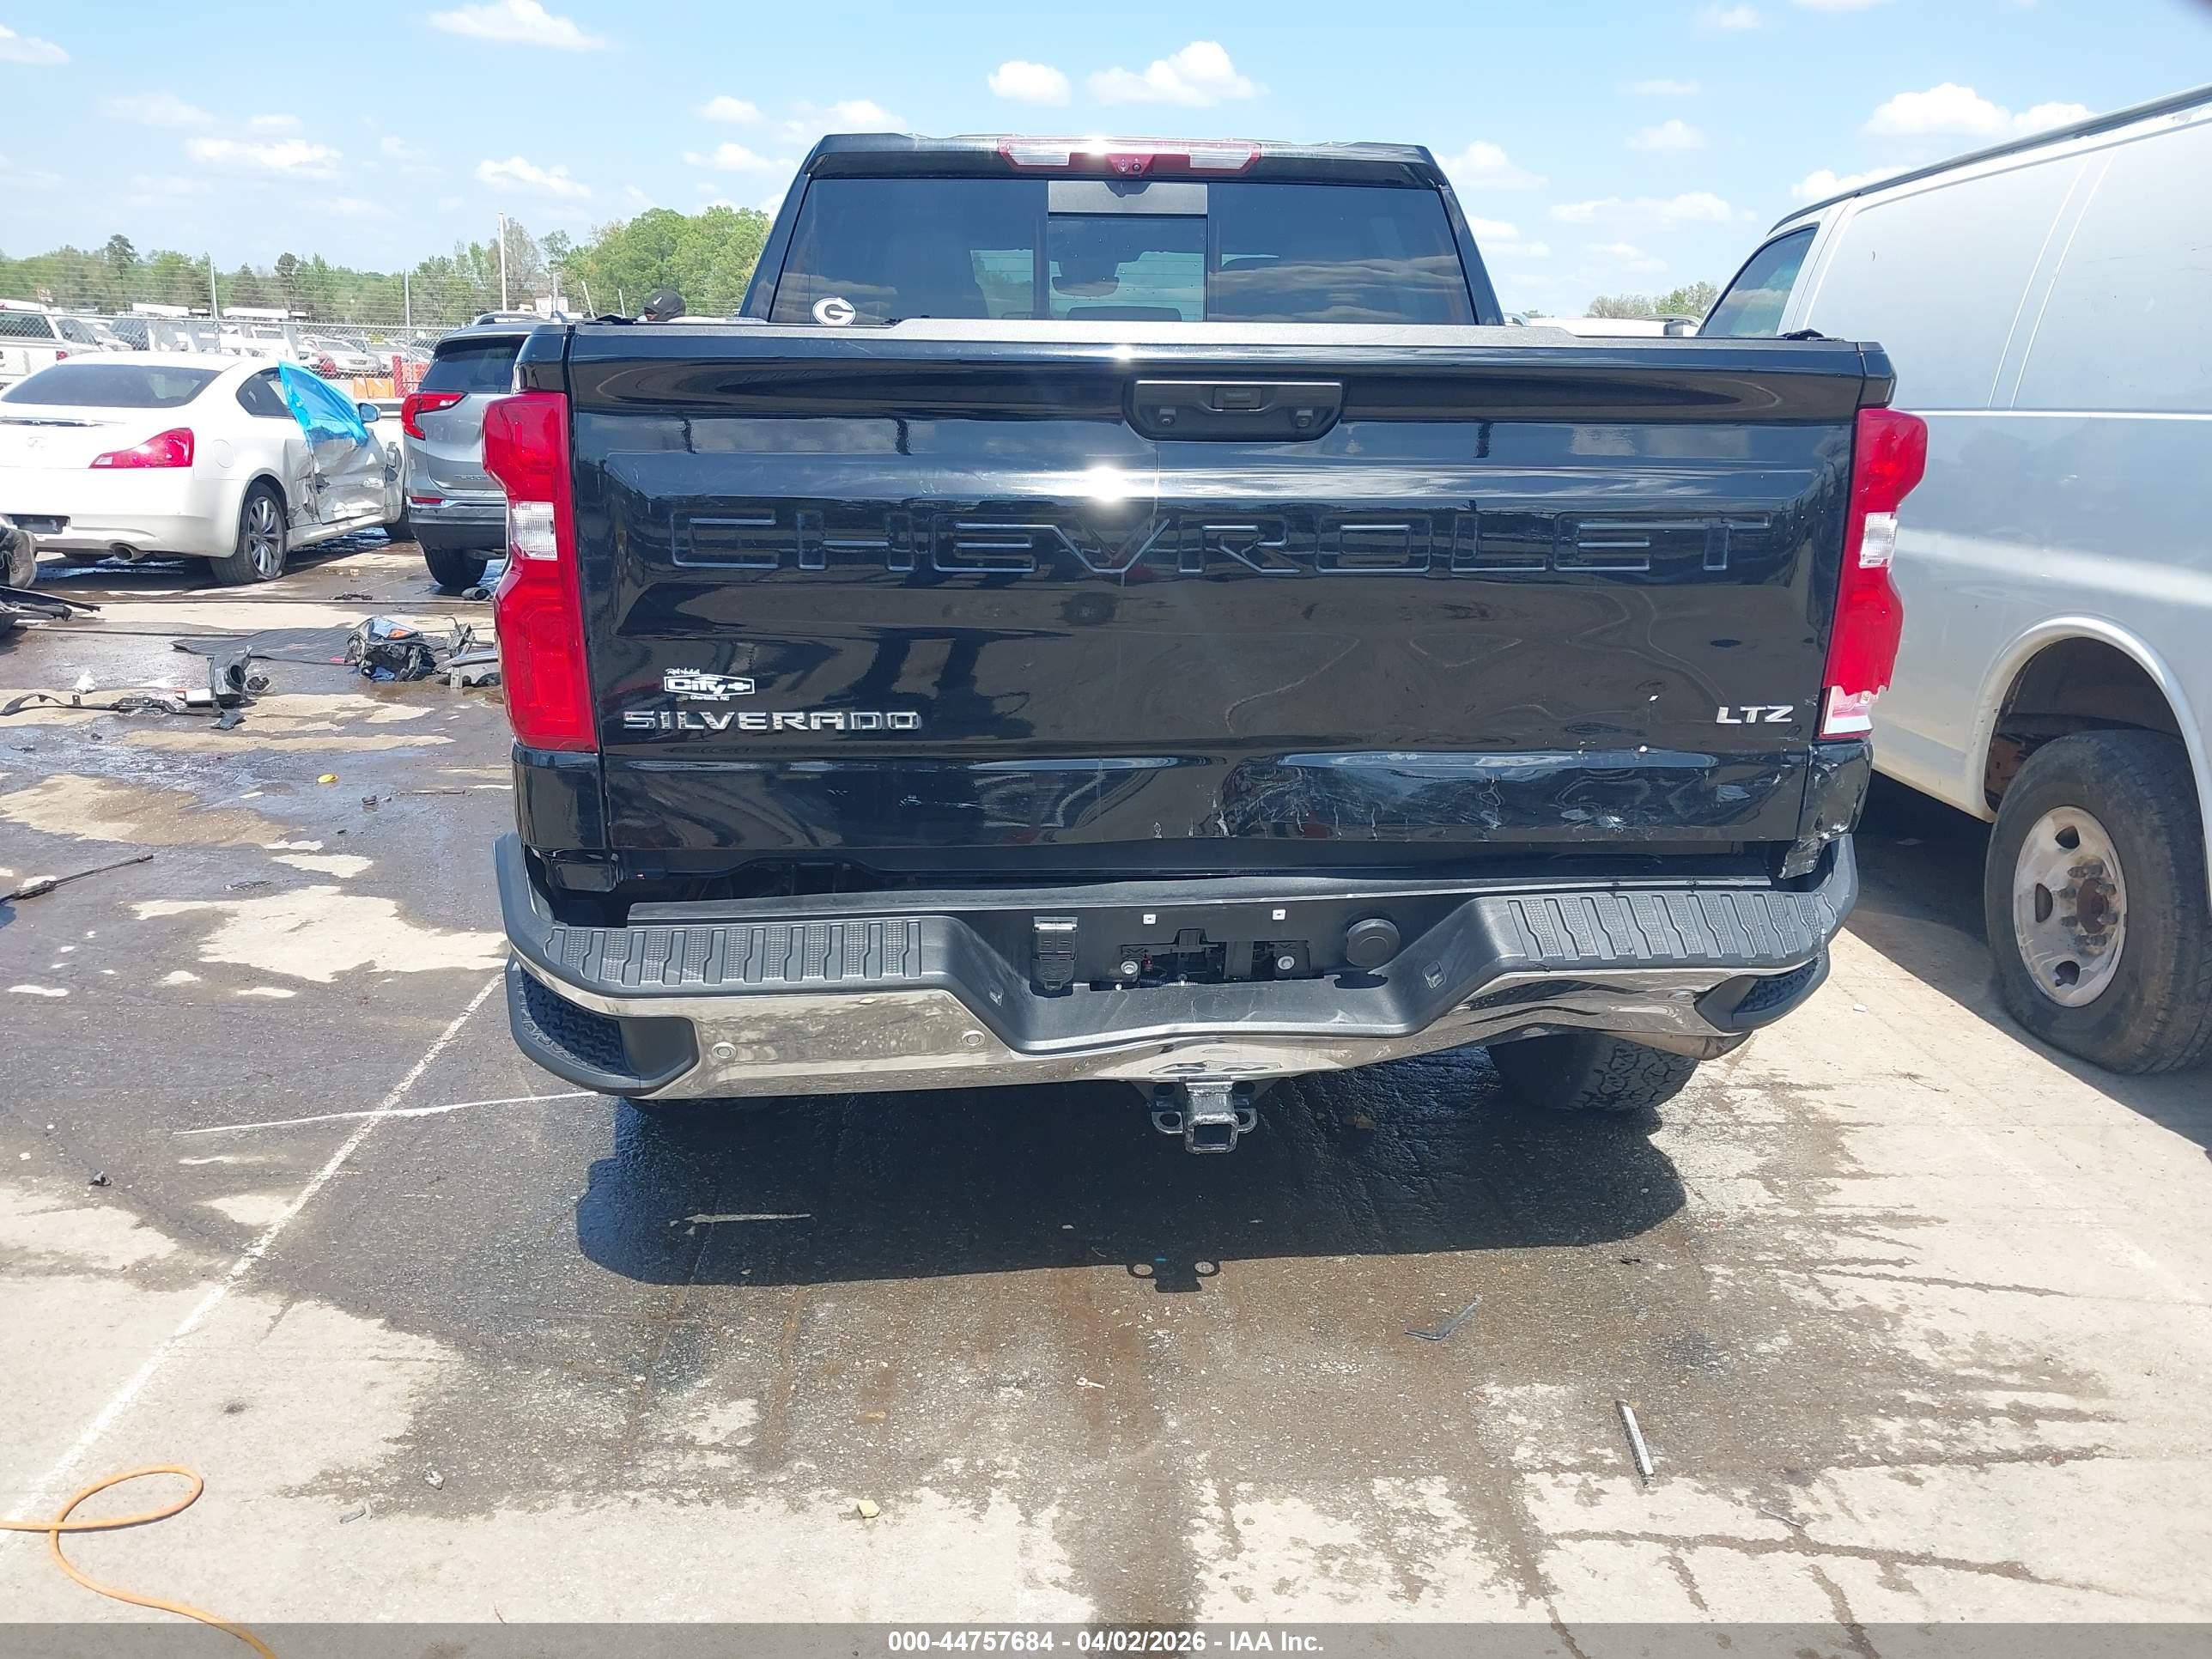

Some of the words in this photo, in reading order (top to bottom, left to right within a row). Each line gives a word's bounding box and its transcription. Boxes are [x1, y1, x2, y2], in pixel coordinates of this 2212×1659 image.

[812, 297, 856, 325] G
[668, 508, 1773, 576] CHEVROLET
[667, 677, 726, 695] City
[623, 710, 922, 732] SILVERADO
[1716, 705, 1794, 725] LTZ
